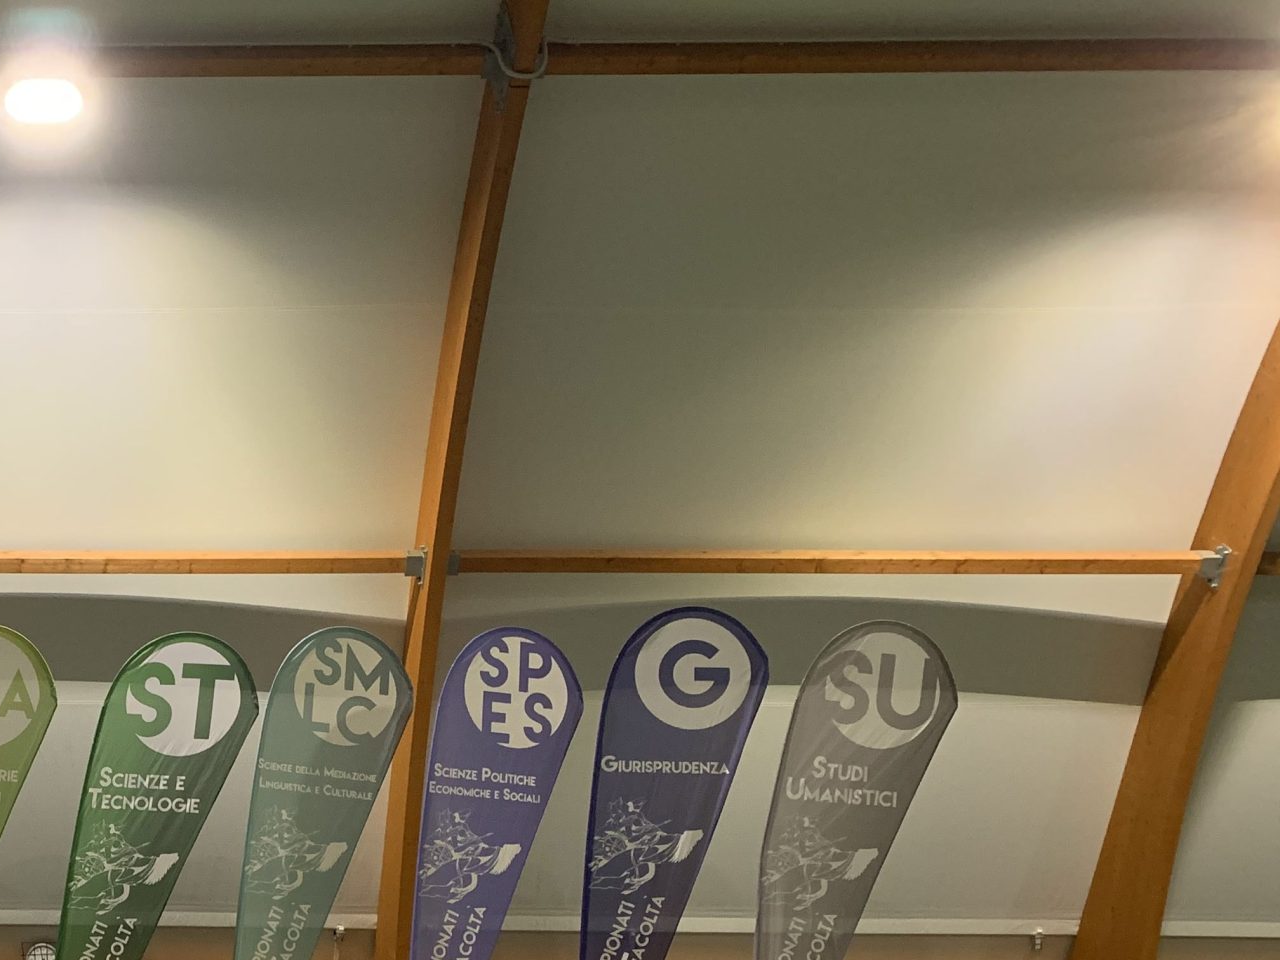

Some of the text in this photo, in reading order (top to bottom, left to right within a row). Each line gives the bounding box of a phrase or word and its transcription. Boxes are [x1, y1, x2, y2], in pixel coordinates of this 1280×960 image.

[658, 639, 730, 708] G
[126, 661, 236, 739] ST
[827, 650, 937, 731] SU
[258, 758, 377, 783] SCIENZE DELLA MEDIAZIONE
[434, 762, 537, 787] SCIENZE POLITICHE
[601, 755, 730, 775] GIURISPRUDENZA
[812, 756, 868, 782] STUDI
[99, 767, 186, 791] SCIENZE E
[259, 777, 374, 801] LINGUISTICA CULTURALE
[88, 787, 200, 814] TECNOLOGIE
[429, 781, 541, 804] ECONOMICHE E SOCIALI
[786, 776, 897, 808] UMANISTICI
